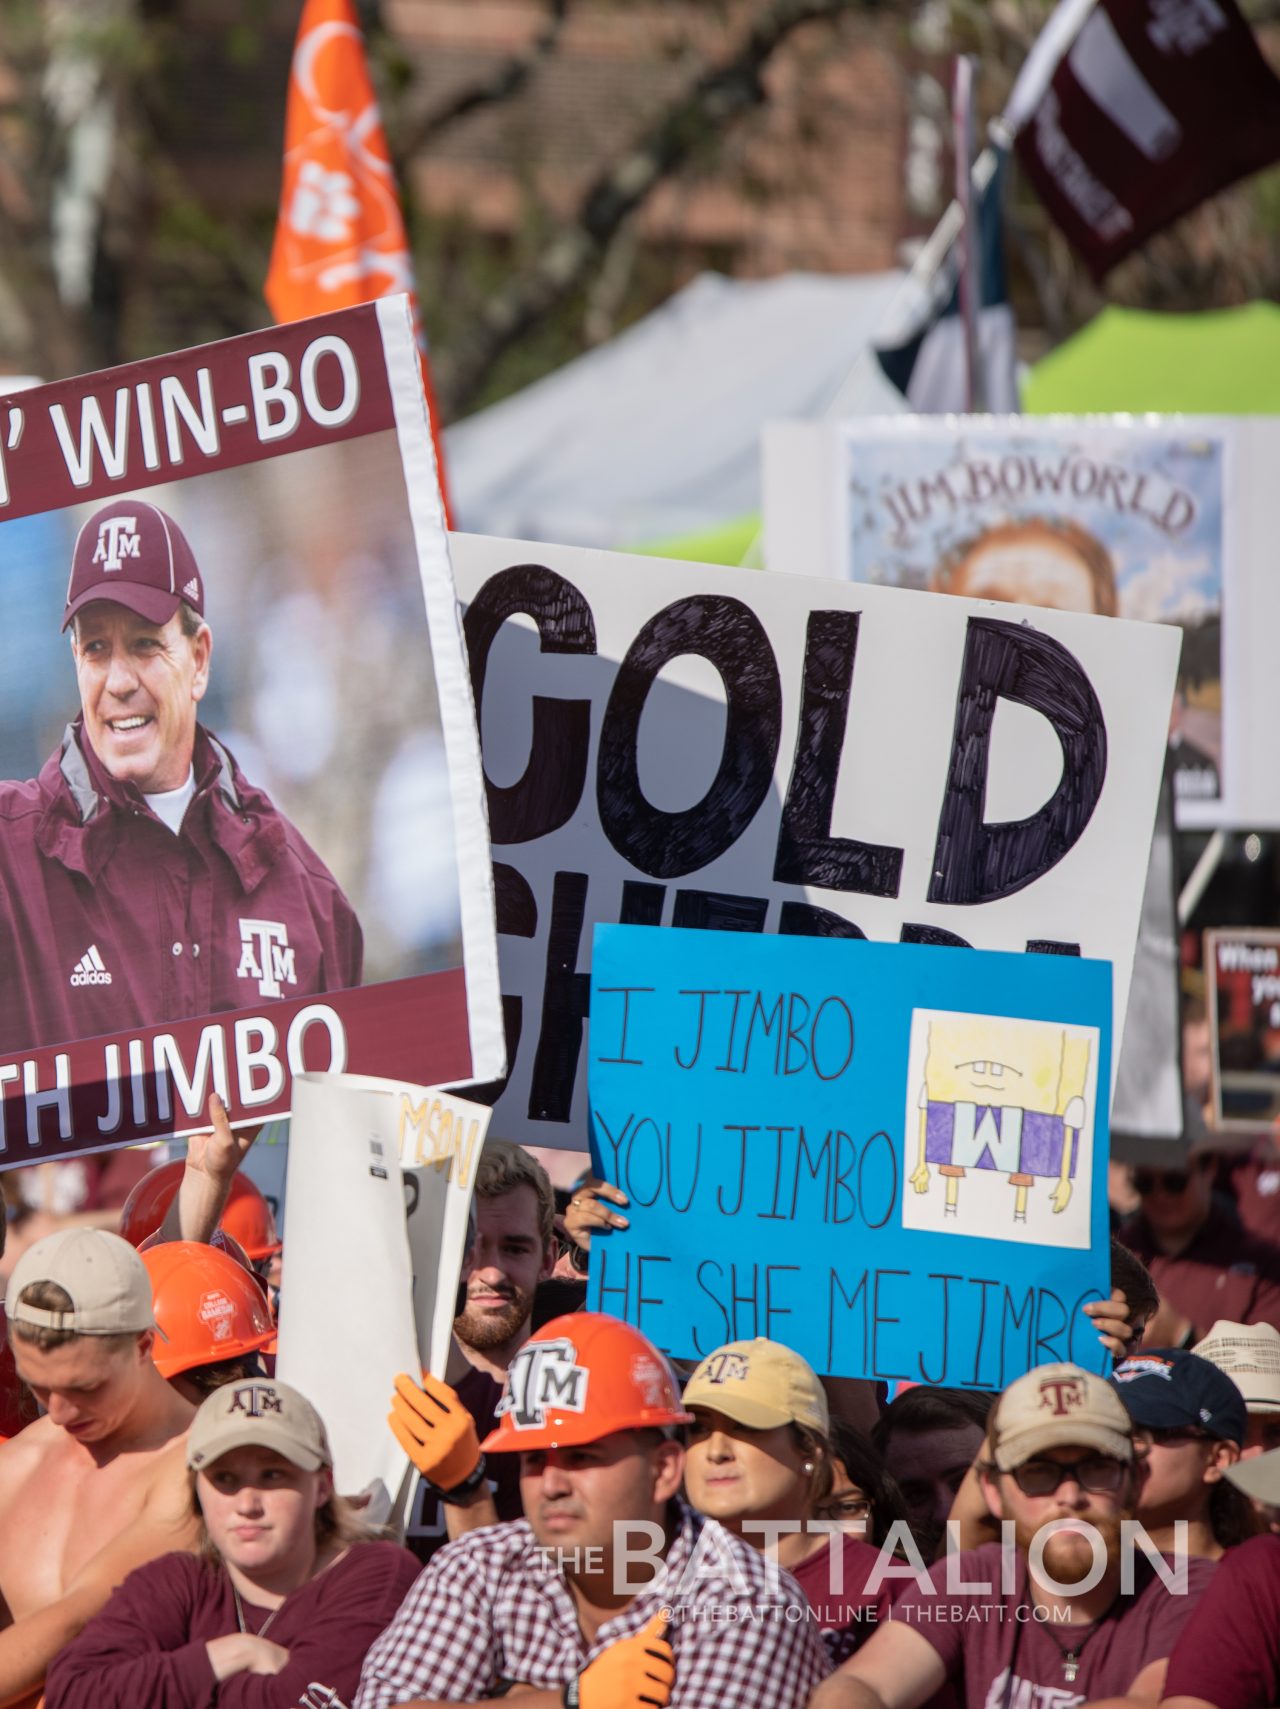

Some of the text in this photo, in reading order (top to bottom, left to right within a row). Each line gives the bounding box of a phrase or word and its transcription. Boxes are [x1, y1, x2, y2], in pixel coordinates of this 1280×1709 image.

[49, 334, 360, 489] WIN-BO
[70, 969, 112, 987] adidas
[597, 985, 855, 1081] I JIMBO
[97, 1003, 349, 1133] JIMBO
[594, 1109, 898, 1230] YOU JIMBO
[692, 1259, 801, 1358] SHE
[827, 1267, 911, 1380] ME
